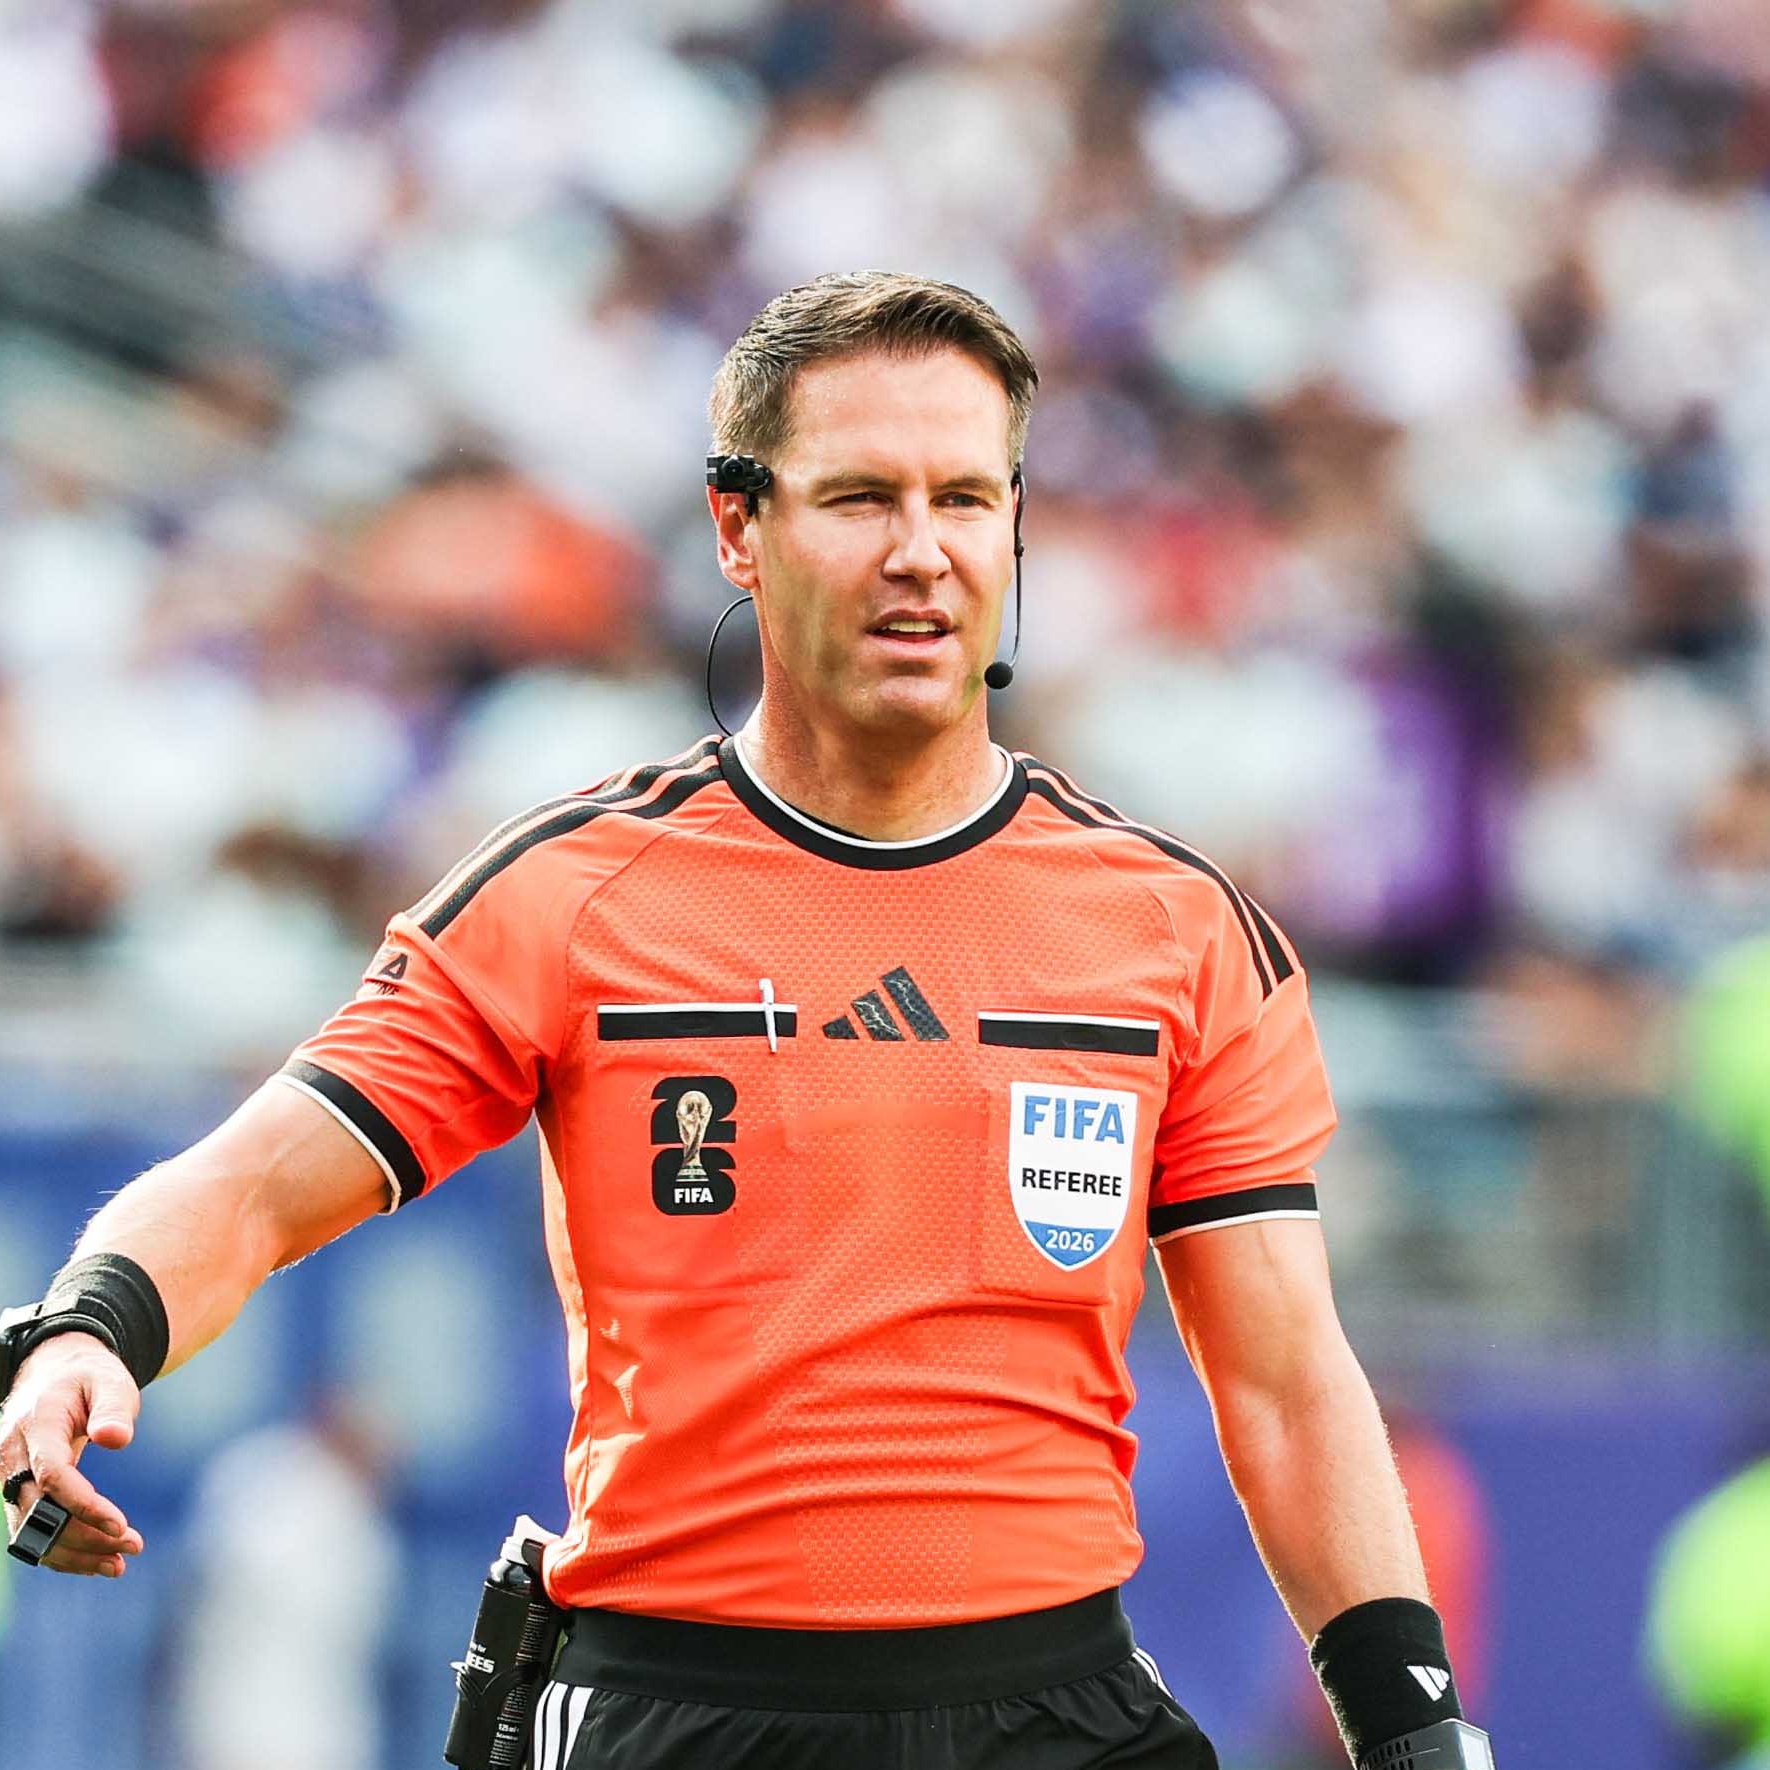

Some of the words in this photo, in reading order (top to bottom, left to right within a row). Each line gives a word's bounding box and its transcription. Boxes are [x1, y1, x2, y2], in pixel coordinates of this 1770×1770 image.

[1024, 1095, 1125, 1144] FIFA
[674, 1187, 714, 1203] FIFA
[1021, 1167, 1122, 1197] REFEREE
[1045, 1229, 1095, 1252] 2026
